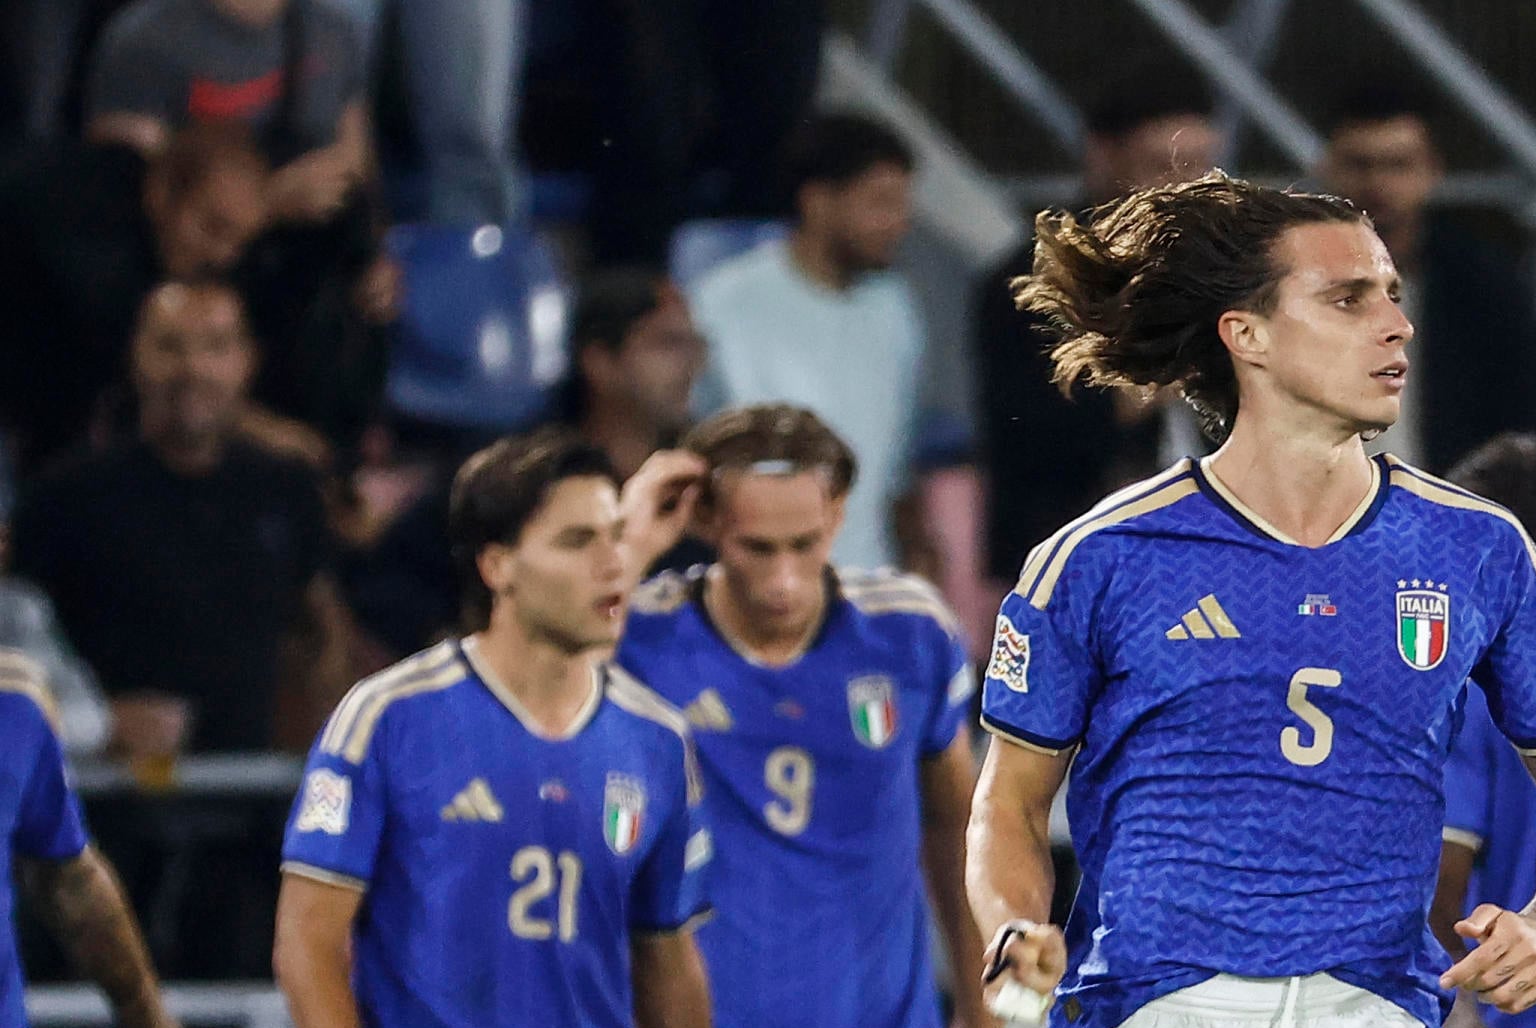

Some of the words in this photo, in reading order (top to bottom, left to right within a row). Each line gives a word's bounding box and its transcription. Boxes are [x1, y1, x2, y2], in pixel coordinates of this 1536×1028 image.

[1400, 597, 1444, 614] ITALIA
[1281, 667, 1342, 767] 5
[763, 746, 814, 837] 9
[508, 846, 581, 943] 21
